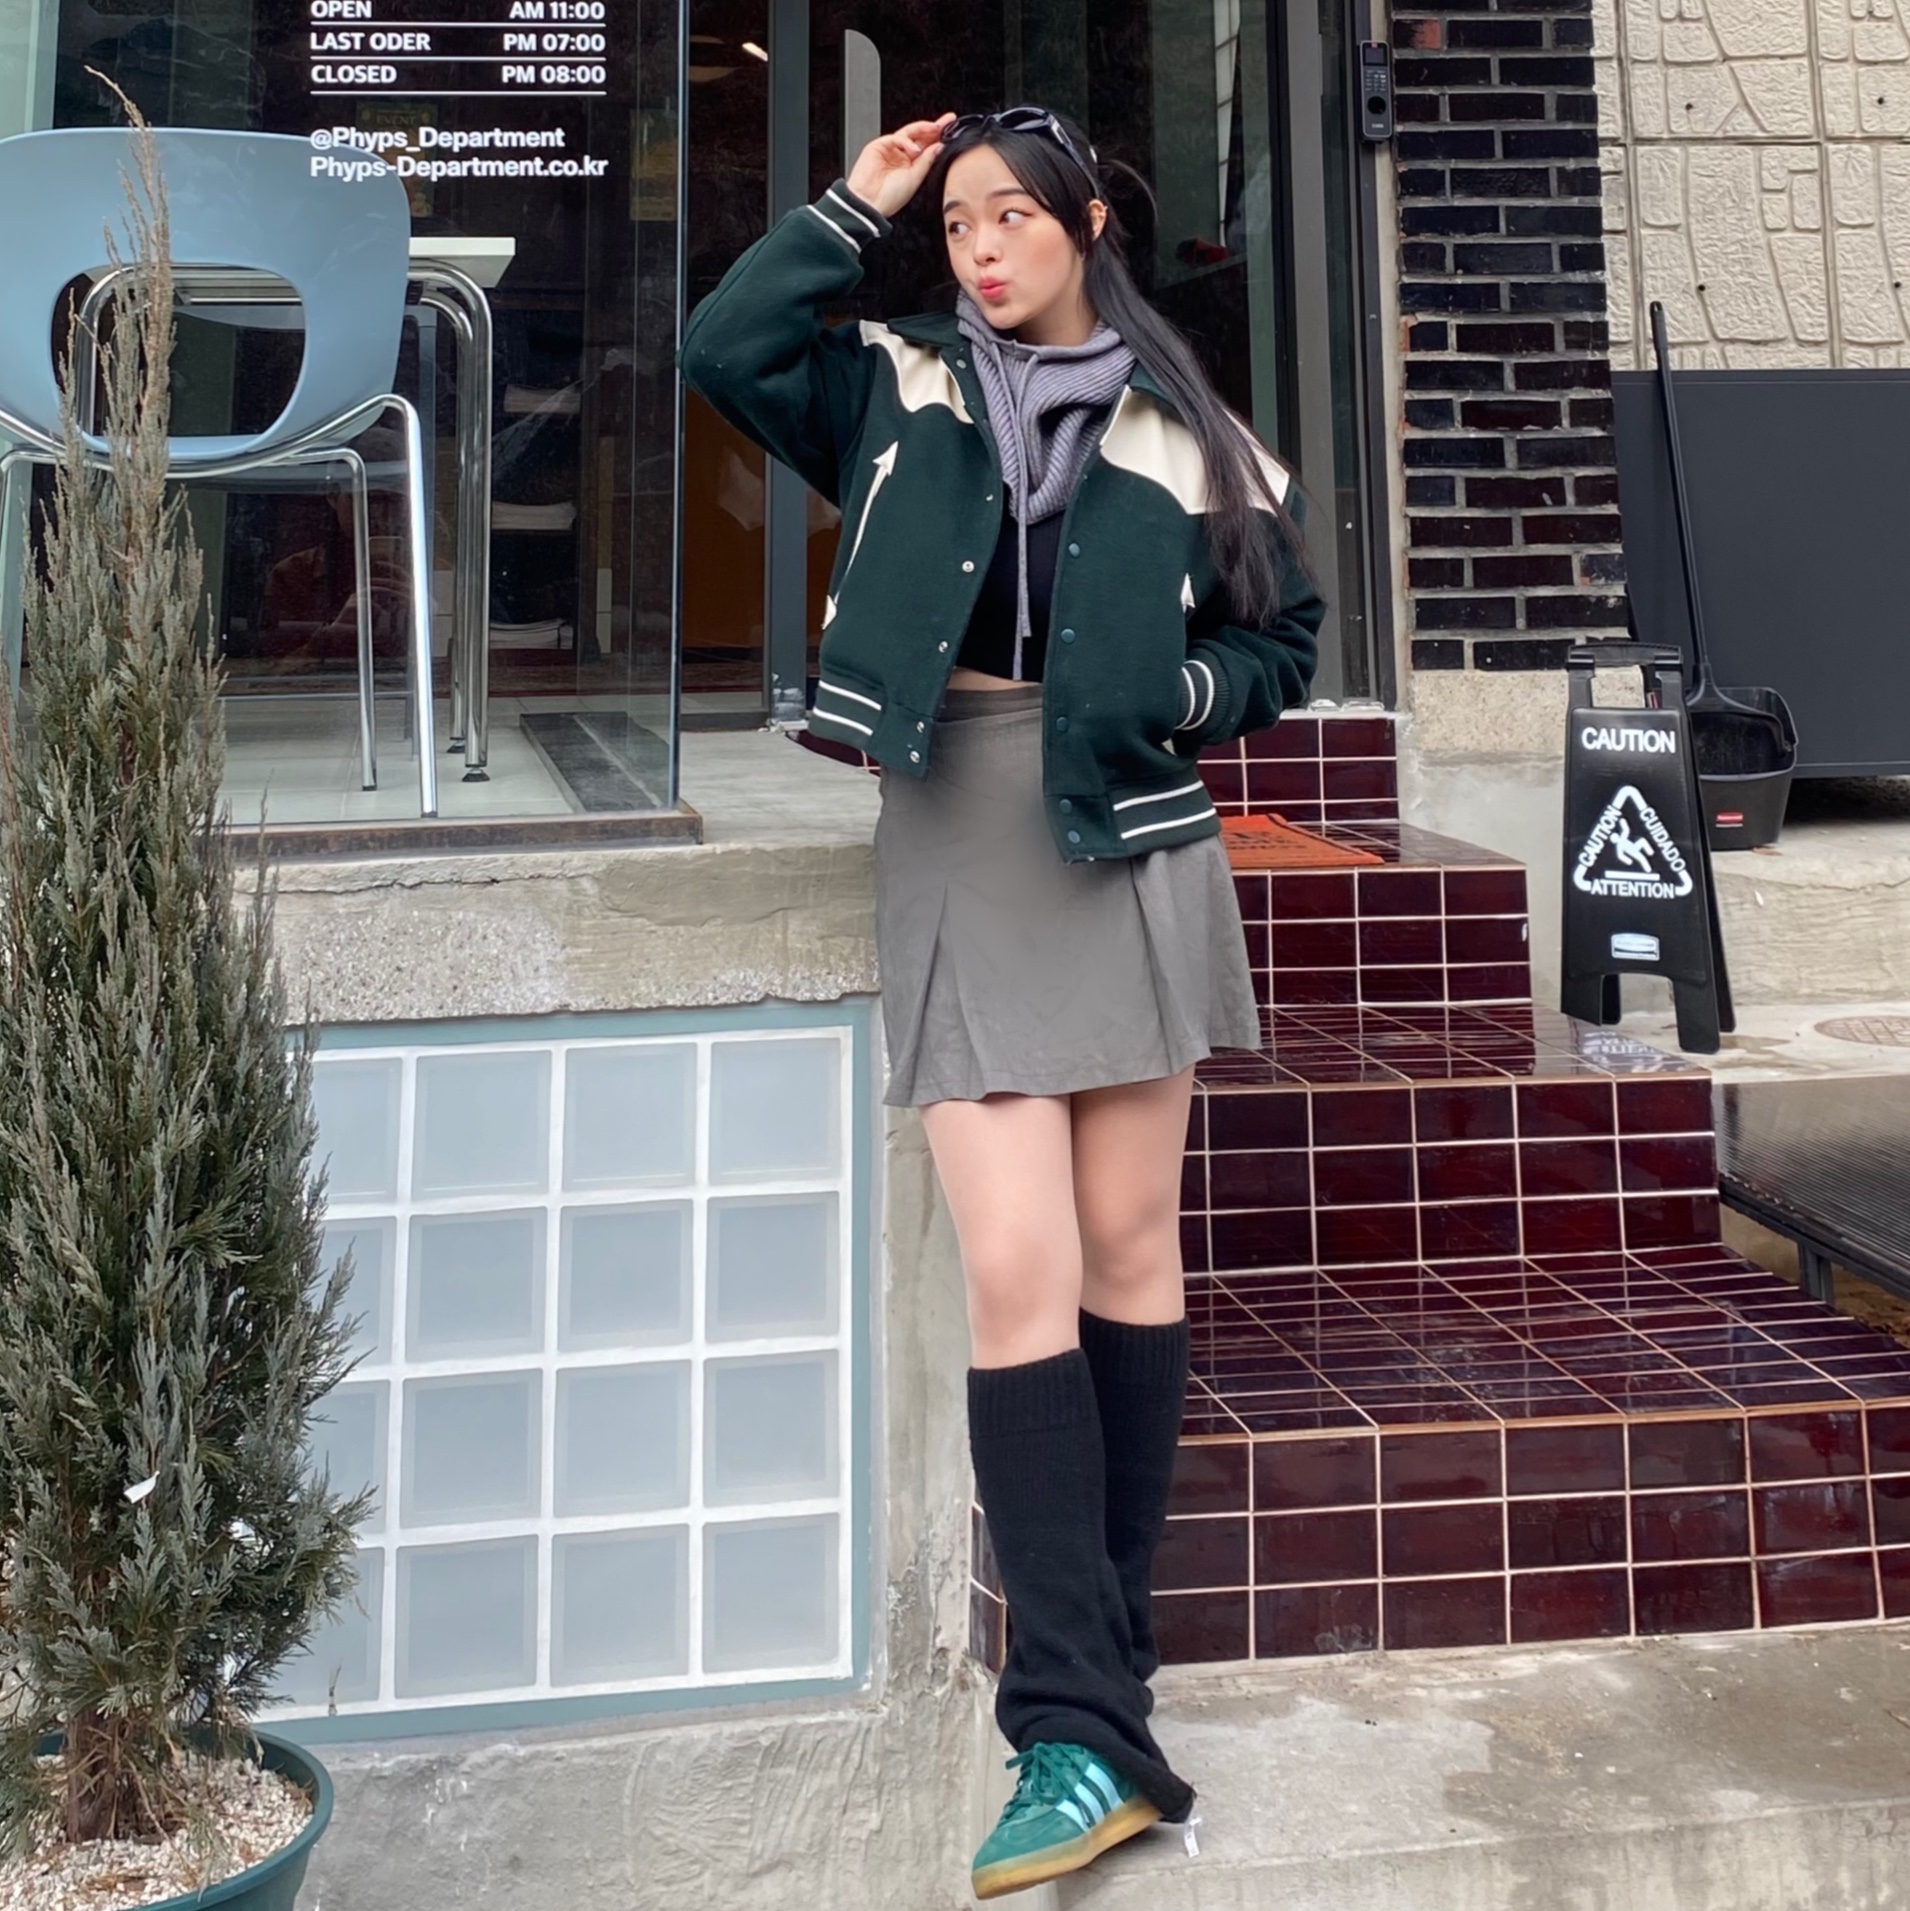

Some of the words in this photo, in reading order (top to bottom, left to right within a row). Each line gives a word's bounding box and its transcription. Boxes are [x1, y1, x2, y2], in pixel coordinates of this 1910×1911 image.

[311, 0, 372, 18] OPEN
[509, 1, 545, 19] AM
[549, 1, 605, 19] 11:00
[310, 32, 364, 50] LAST
[369, 33, 431, 50] ODER
[503, 34, 538, 51] PM
[542, 34, 606, 51] 07:00
[311, 65, 397, 83] CLOSED
[502, 66, 535, 83] PM
[541, 66, 606, 83] 08:00
[310, 127, 565, 152] @Phyps_Department
[310, 156, 608, 181] Phyps-Department.co.kr
[1581, 727, 1676, 754] CAUTION
[1578, 804, 1622, 868] CAUTION
[1640, 807, 1686, 872] CUIDADO
[1591, 879, 1675, 899] ATTENTION
